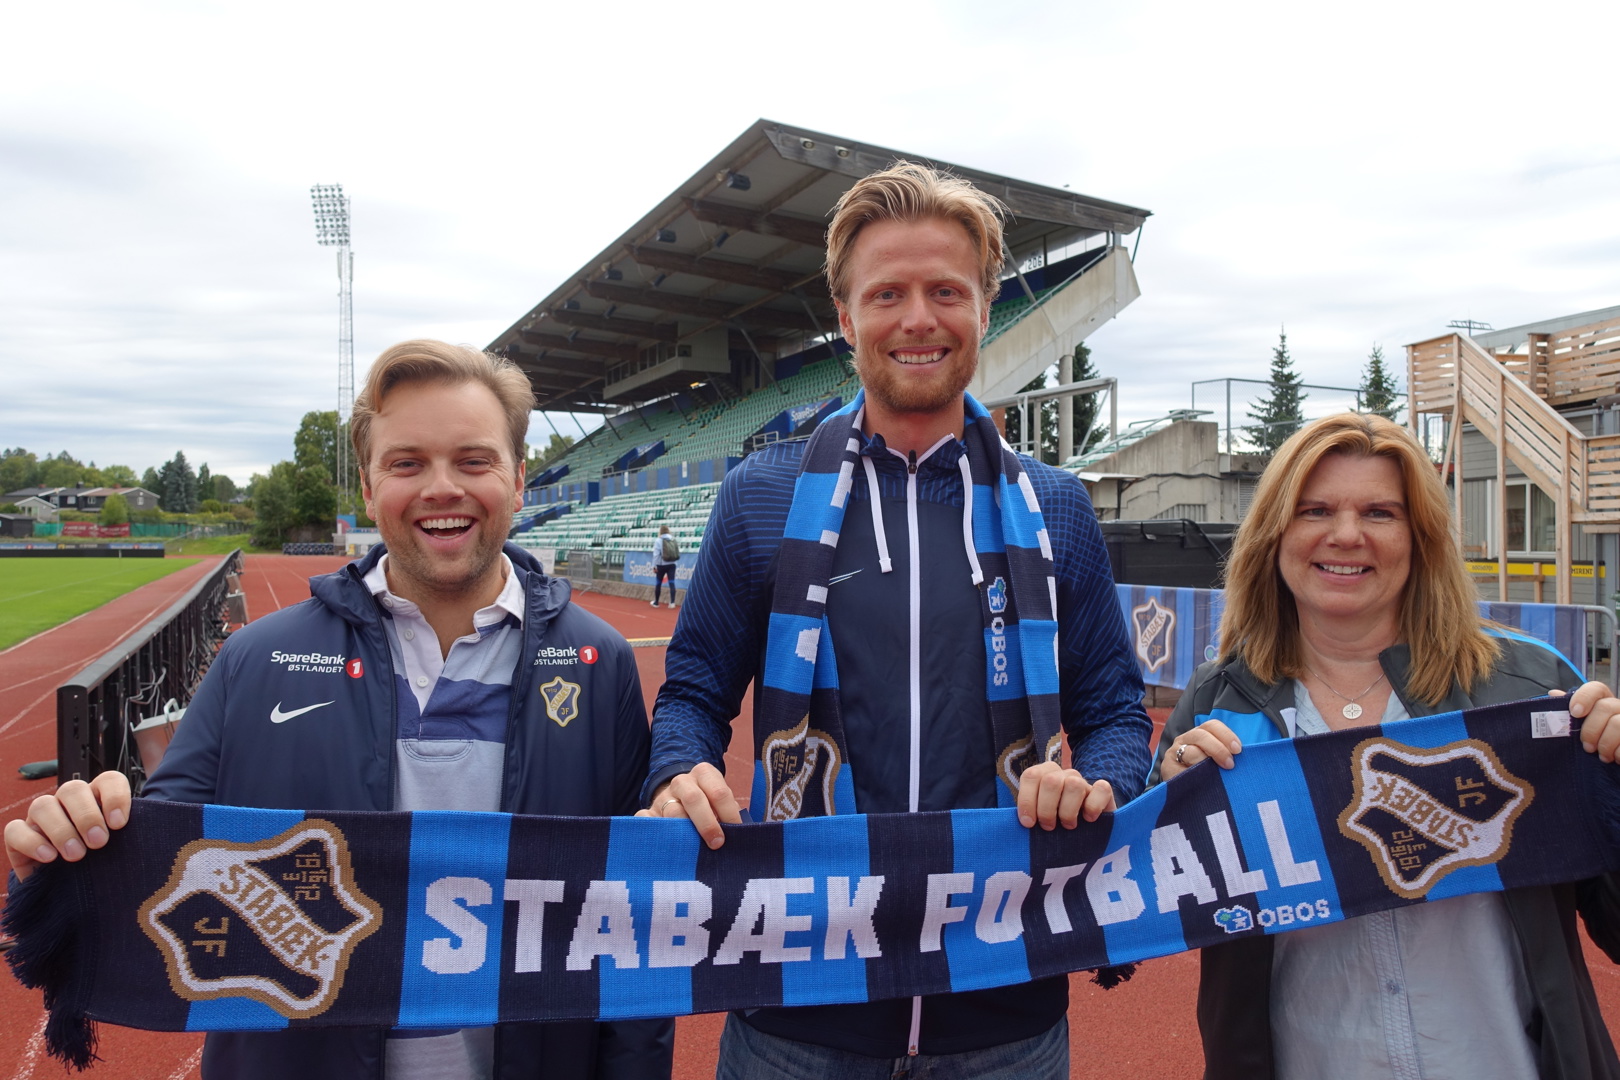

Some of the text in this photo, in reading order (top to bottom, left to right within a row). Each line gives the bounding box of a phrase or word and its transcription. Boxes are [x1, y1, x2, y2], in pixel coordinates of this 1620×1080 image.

[1028, 255, 1042, 270] 206
[271, 650, 361, 675] SpareBank 1
[537, 646, 592, 661] reBank 1
[991, 617, 1008, 686] OBOS
[288, 664, 344, 673] ØSTLANDET
[1455, 775, 1487, 808] JF
[1369, 776, 1474, 849] STABÆK
[421, 799, 1322, 974] STABÆK FOTBALL
[219, 863, 335, 970] STABÆK
[1256, 898, 1331, 927] OBOS
[192, 916, 230, 958] JF
